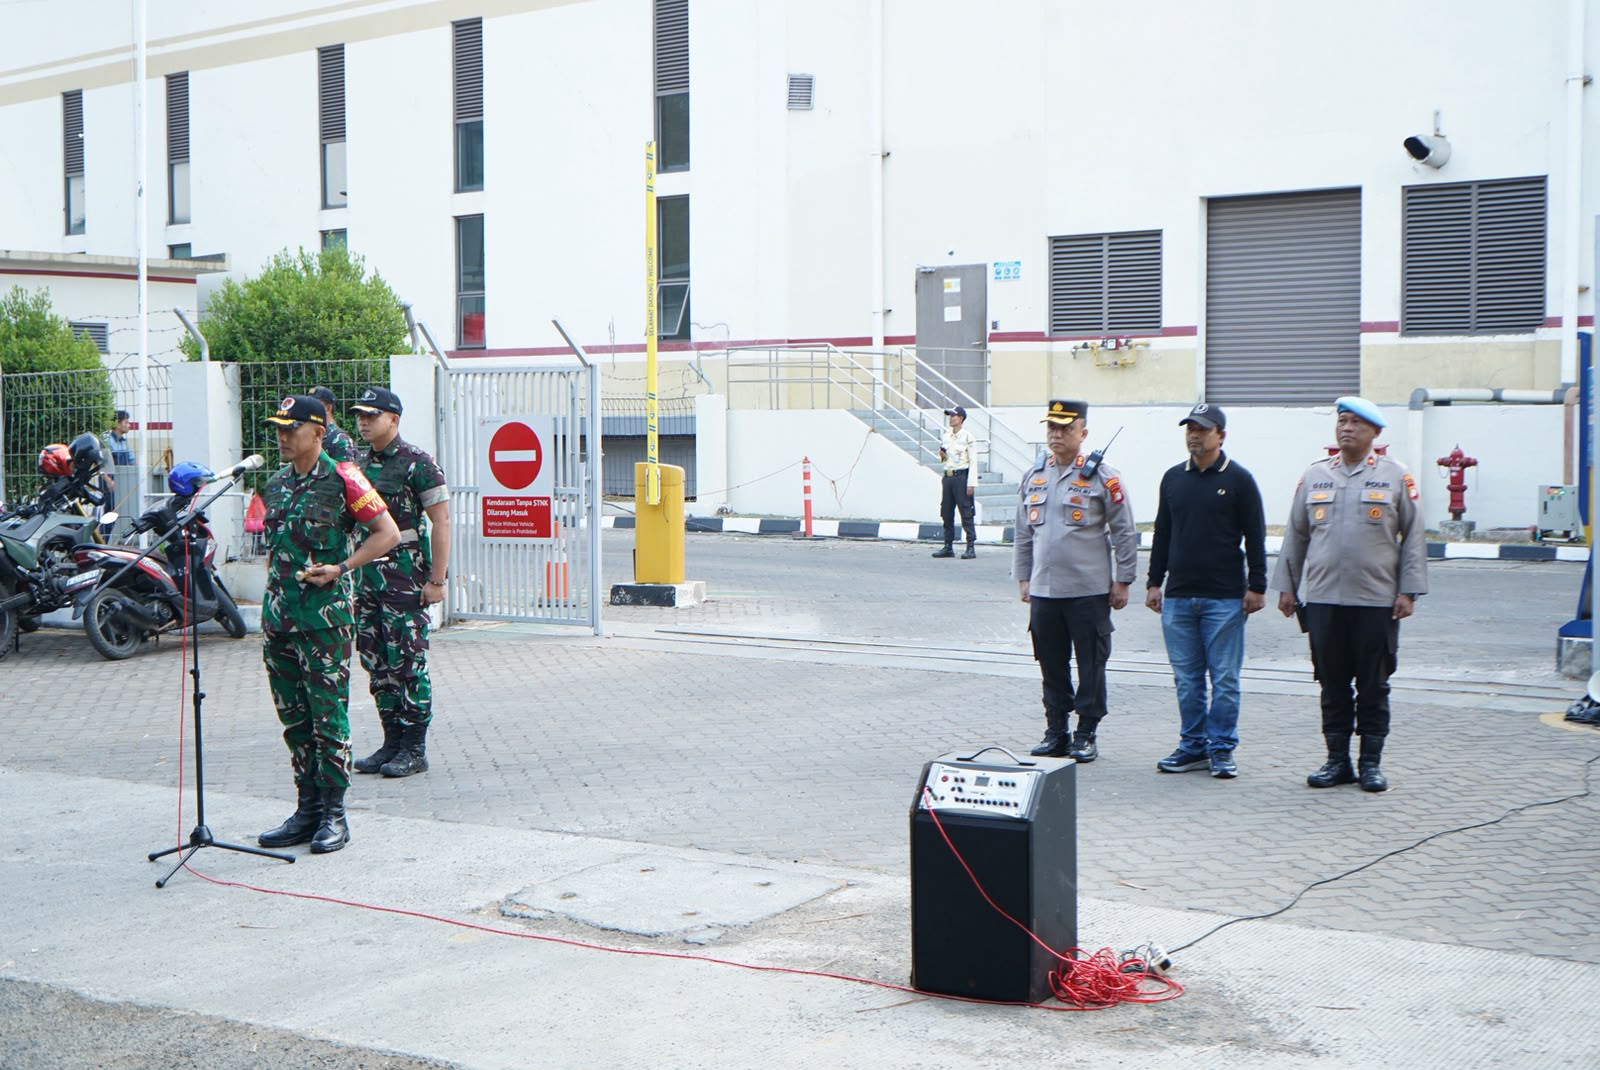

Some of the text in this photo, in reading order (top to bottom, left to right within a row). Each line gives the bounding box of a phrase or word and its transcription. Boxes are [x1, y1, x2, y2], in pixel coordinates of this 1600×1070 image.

[486, 498, 549, 507] Kendaraan Tanpa STNK
[486, 508, 510, 517] Dilarang
